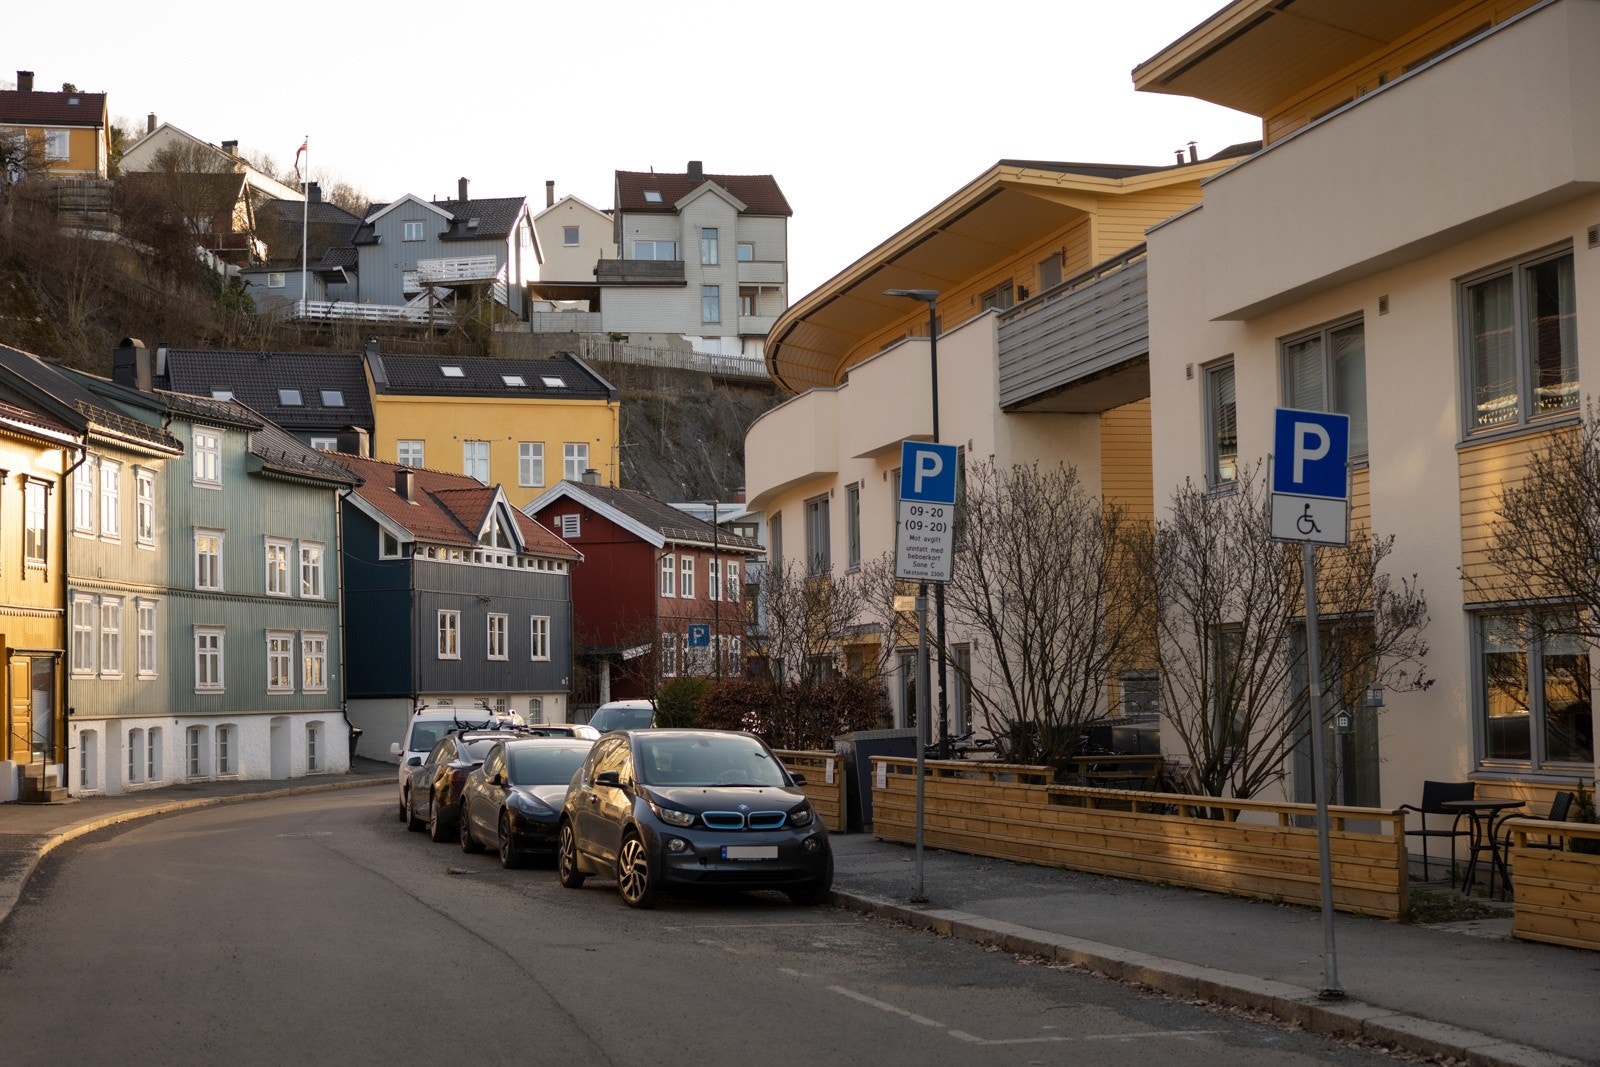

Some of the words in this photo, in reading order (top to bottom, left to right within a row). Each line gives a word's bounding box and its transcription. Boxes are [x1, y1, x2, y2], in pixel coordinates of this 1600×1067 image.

[1292, 421, 1330, 484] P
[914, 450, 942, 493] P
[910, 506, 944, 518] 09-20
[905, 520, 947, 533] (09-20)
[693, 628, 704, 643] P
